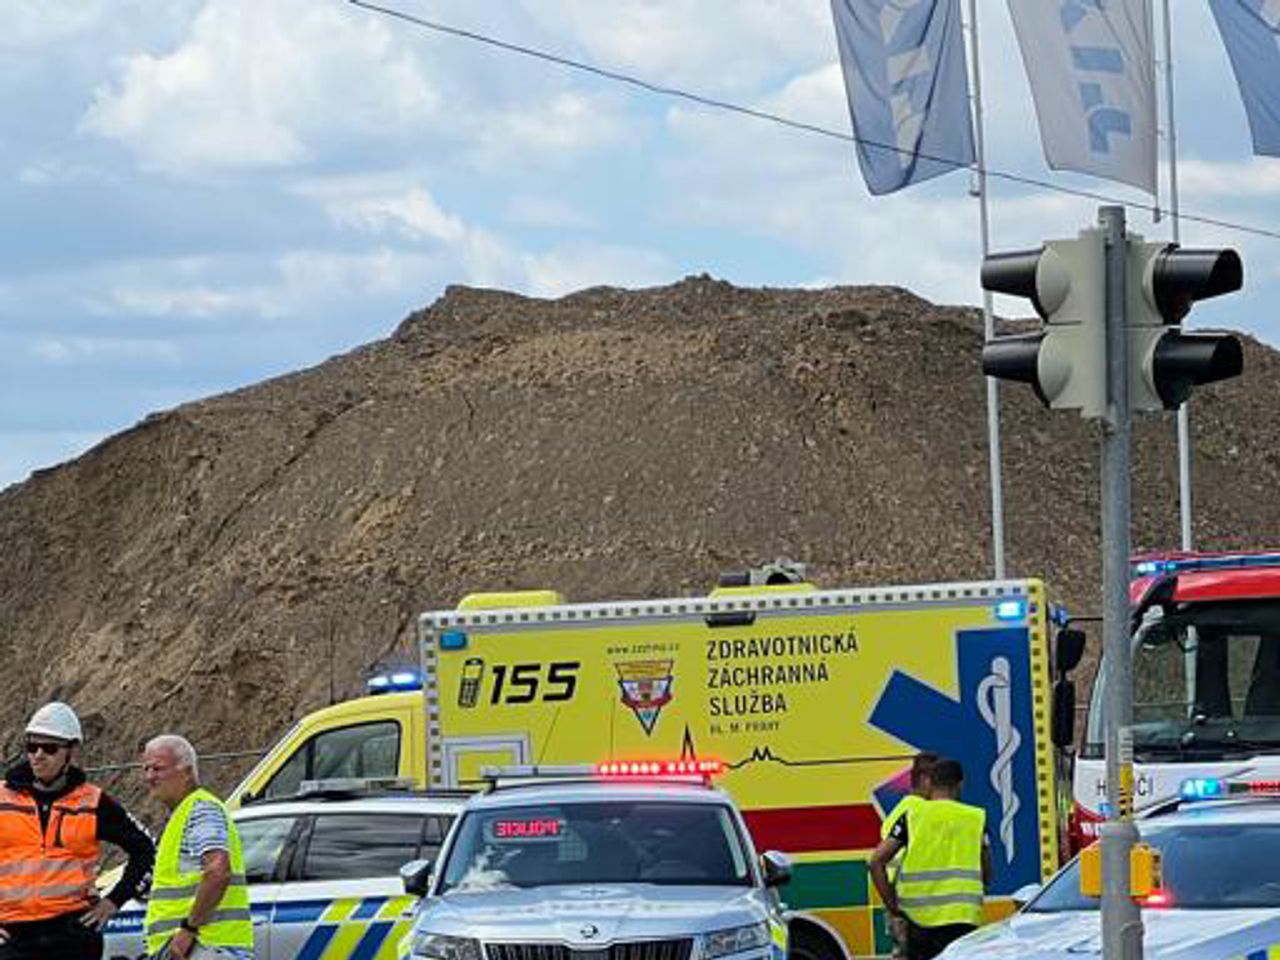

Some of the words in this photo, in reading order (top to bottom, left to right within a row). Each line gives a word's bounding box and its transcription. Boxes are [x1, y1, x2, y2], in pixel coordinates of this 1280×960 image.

[706, 626, 859, 661] ZDRAVOTNICKÁ
[490, 661, 582, 706] 155
[707, 657, 829, 689] ZÁCHRANNÁ
[709, 690, 787, 717] SLUŽBA
